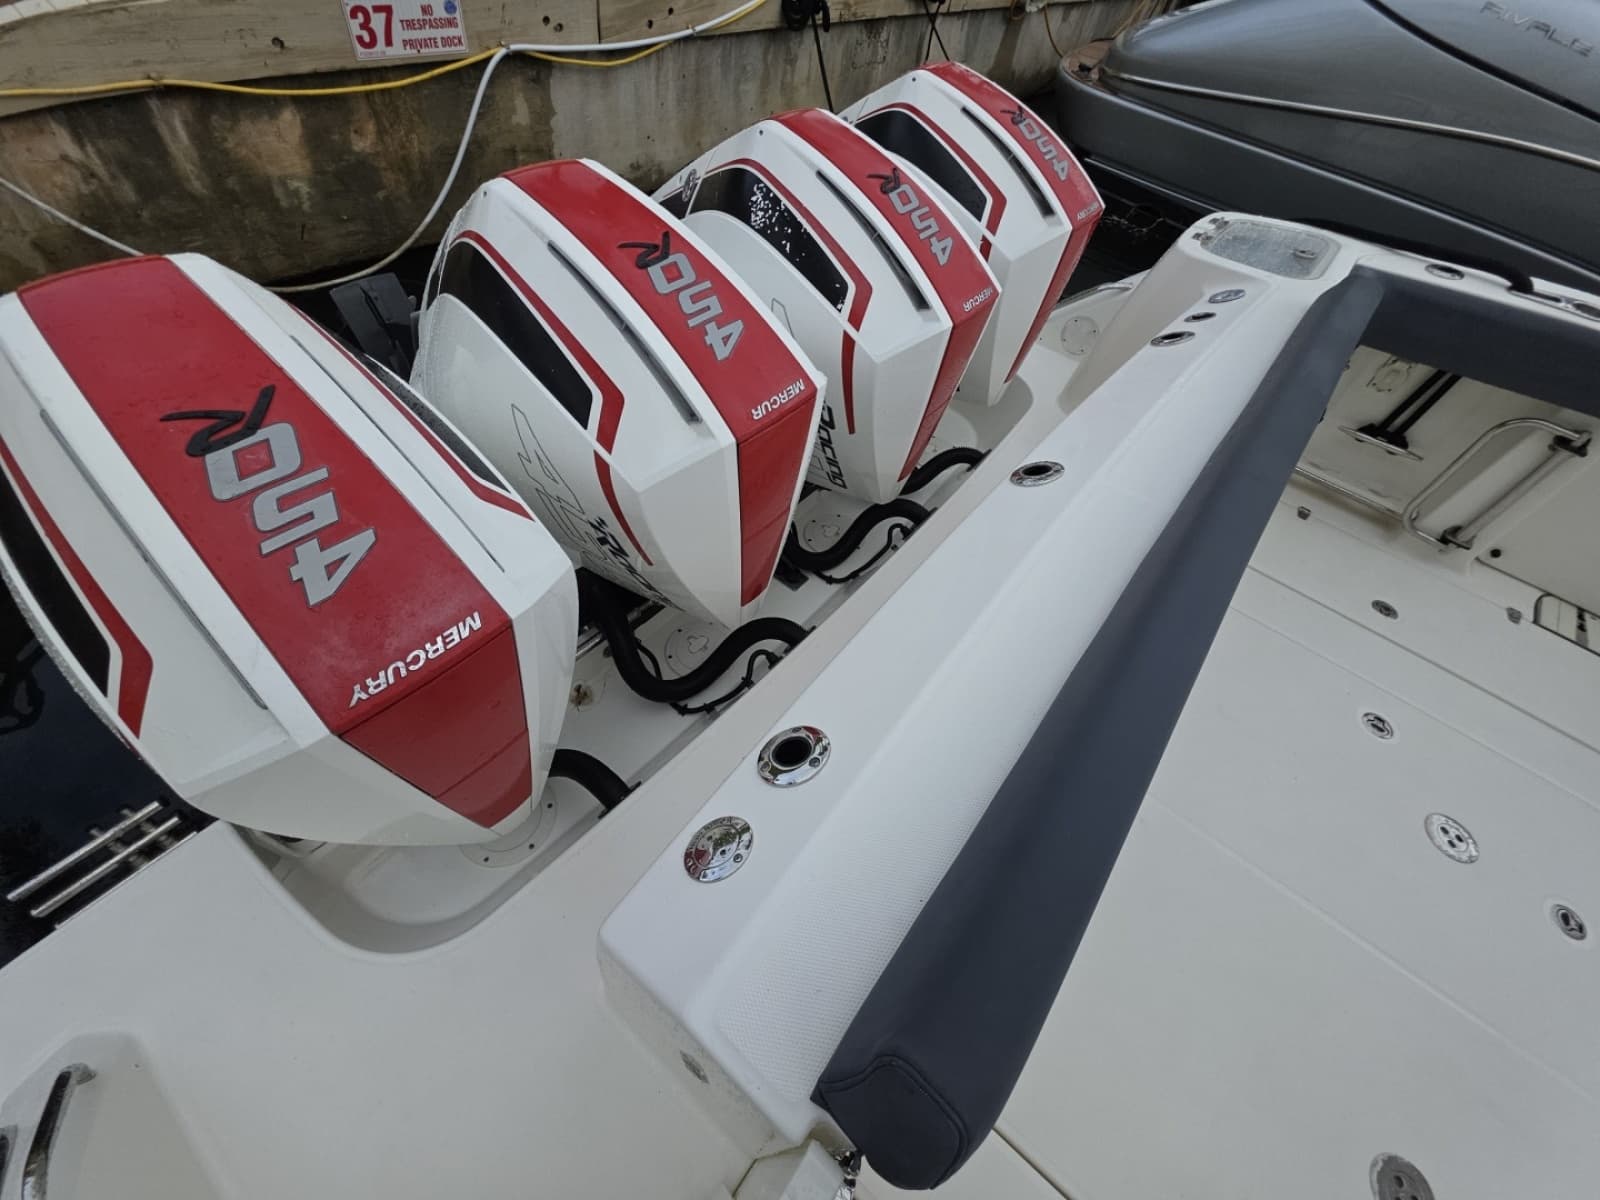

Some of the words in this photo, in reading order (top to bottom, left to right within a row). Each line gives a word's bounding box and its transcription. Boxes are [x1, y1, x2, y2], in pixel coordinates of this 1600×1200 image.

[350, 5, 393, 49] 37
[400, 17, 458, 31] TRESPASSING
[402, 37, 439, 50] PRIVATE
[441, 36, 463, 48] DOCK
[420, 4, 433, 16] NO
[867, 167, 953, 266] 450R
[617, 231, 744, 361] 450R
[160, 385, 377, 608] 450R
[349, 611, 482, 709] MERCURY
